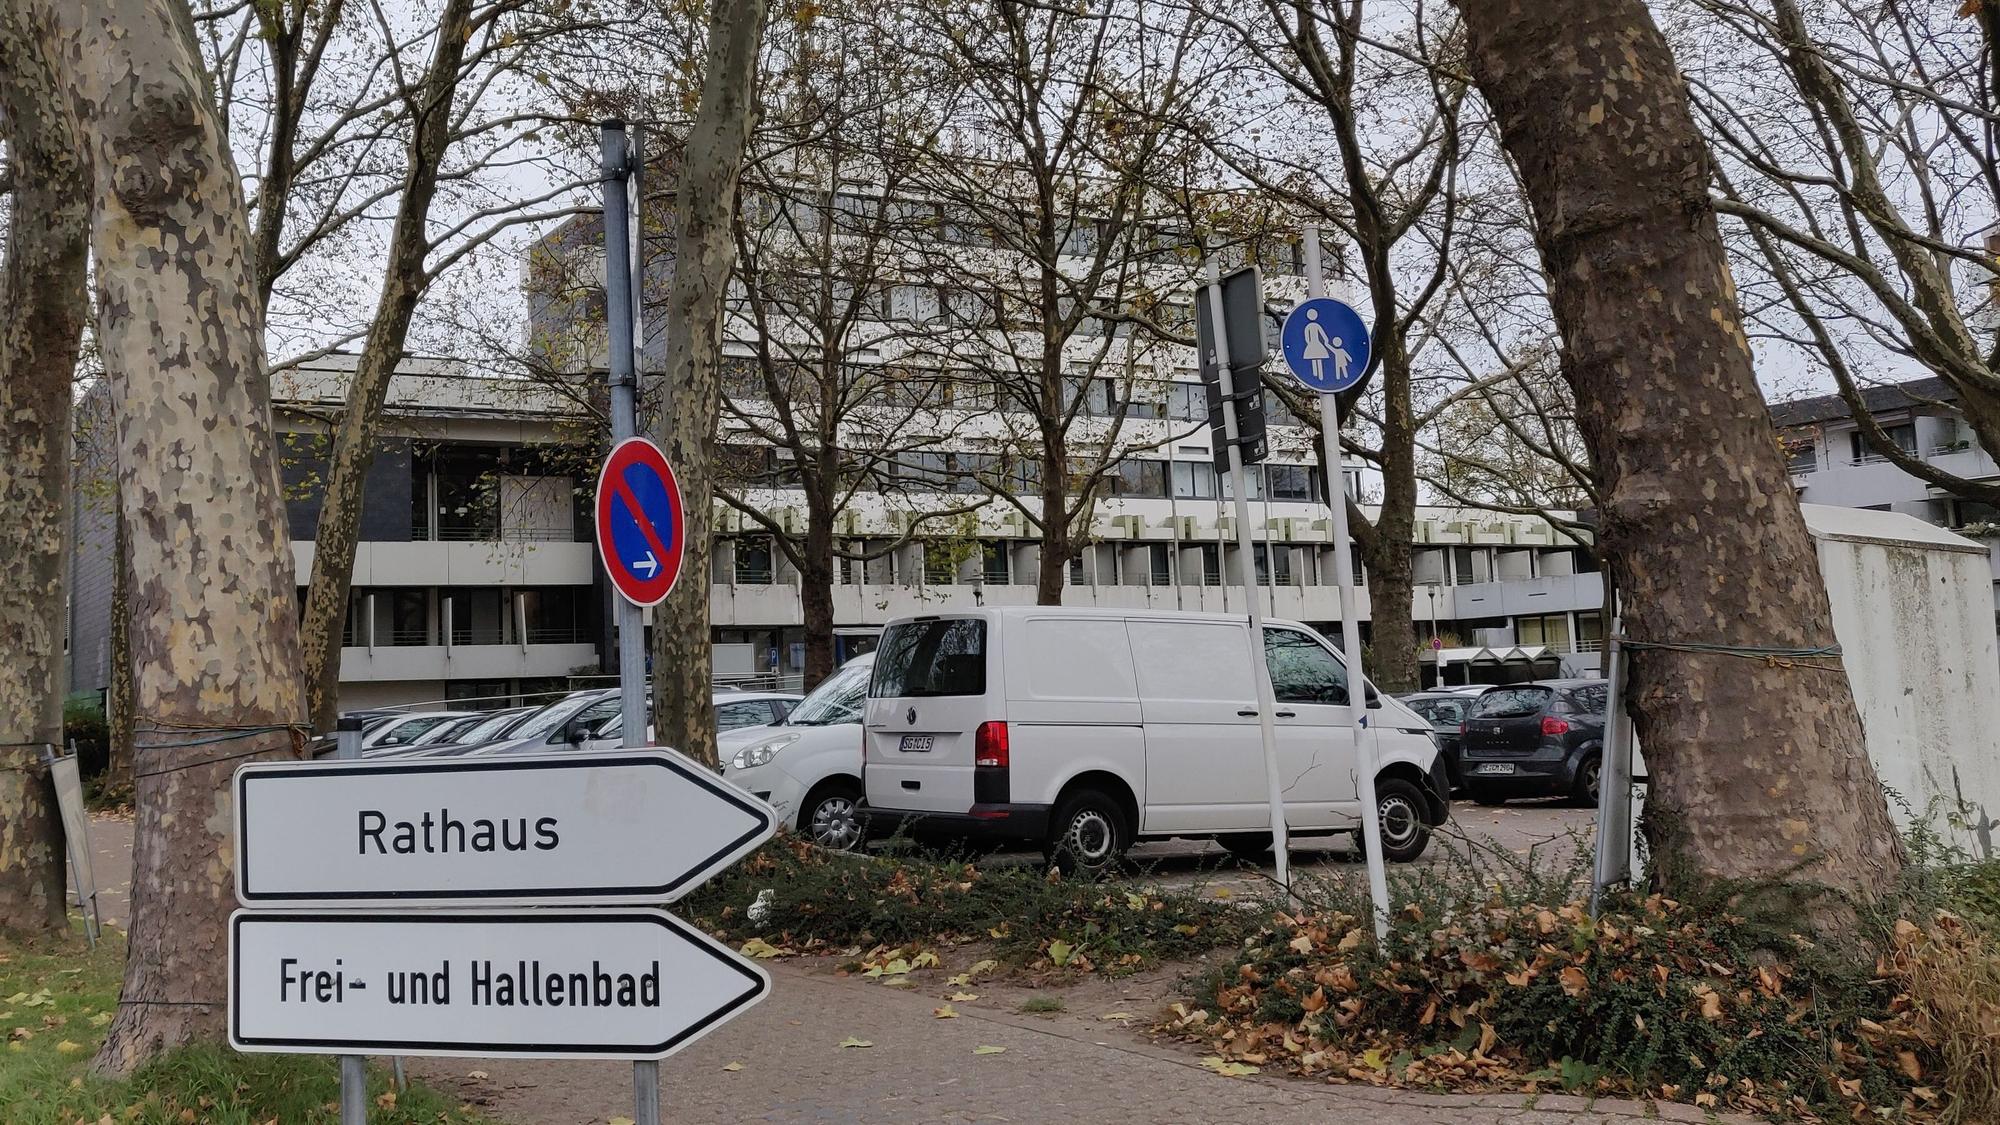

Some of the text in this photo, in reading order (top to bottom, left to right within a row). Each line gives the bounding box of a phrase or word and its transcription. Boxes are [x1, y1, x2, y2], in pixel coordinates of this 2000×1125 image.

[903, 737, 914, 749] SG
[358, 808, 560, 855] Rathaus
[280, 958, 660, 1008] Frei- und Hallenbad
